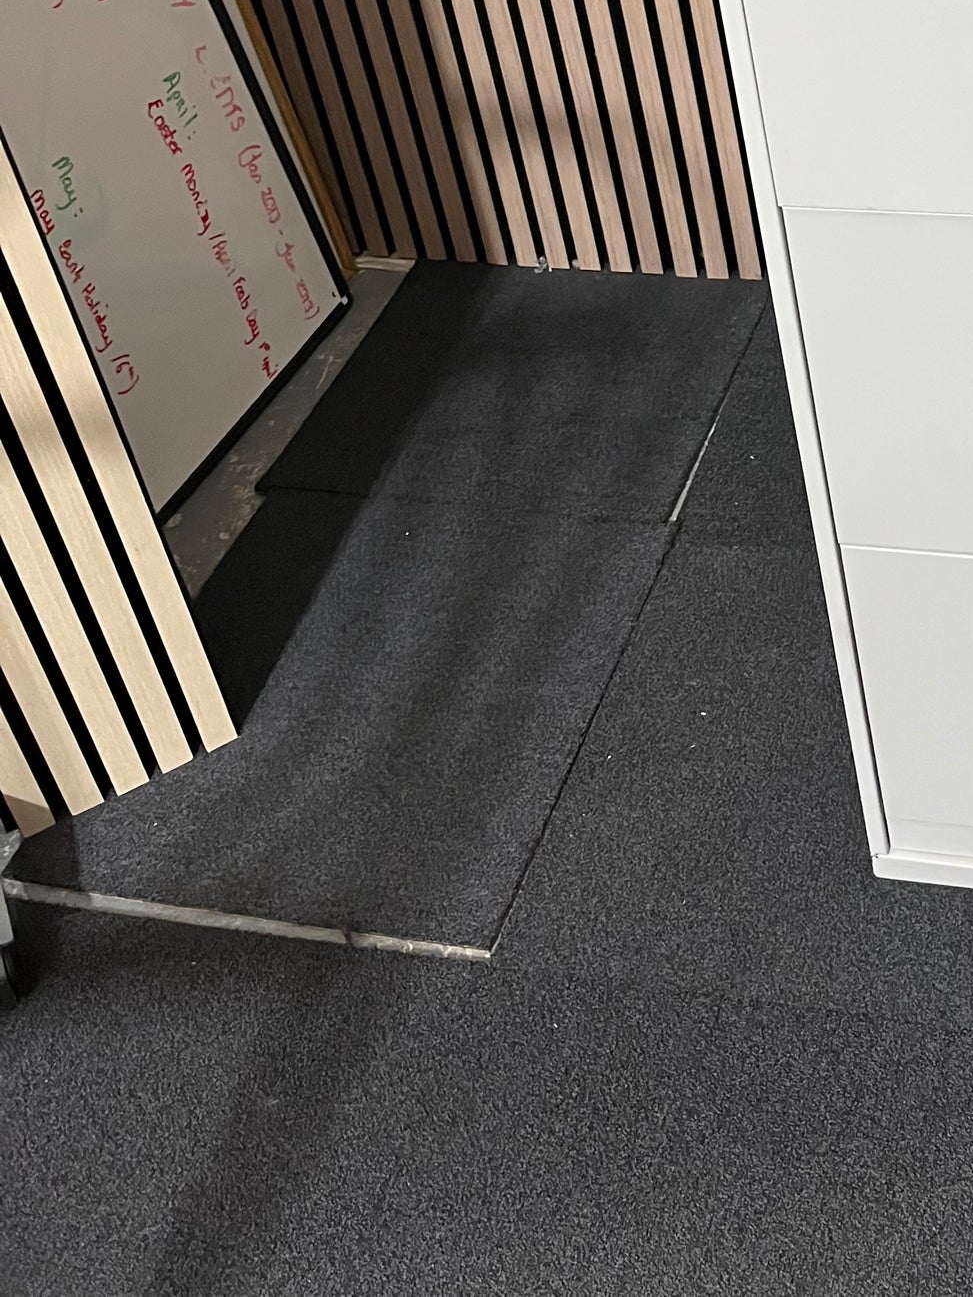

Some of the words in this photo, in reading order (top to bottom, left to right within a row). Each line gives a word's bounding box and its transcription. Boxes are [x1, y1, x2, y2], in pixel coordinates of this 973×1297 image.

[148, 99, 183, 156] Easter
[52, 156, 84, 218] May:
[30, 189, 56, 237] May
[82, 281, 113, 353] Holiday
